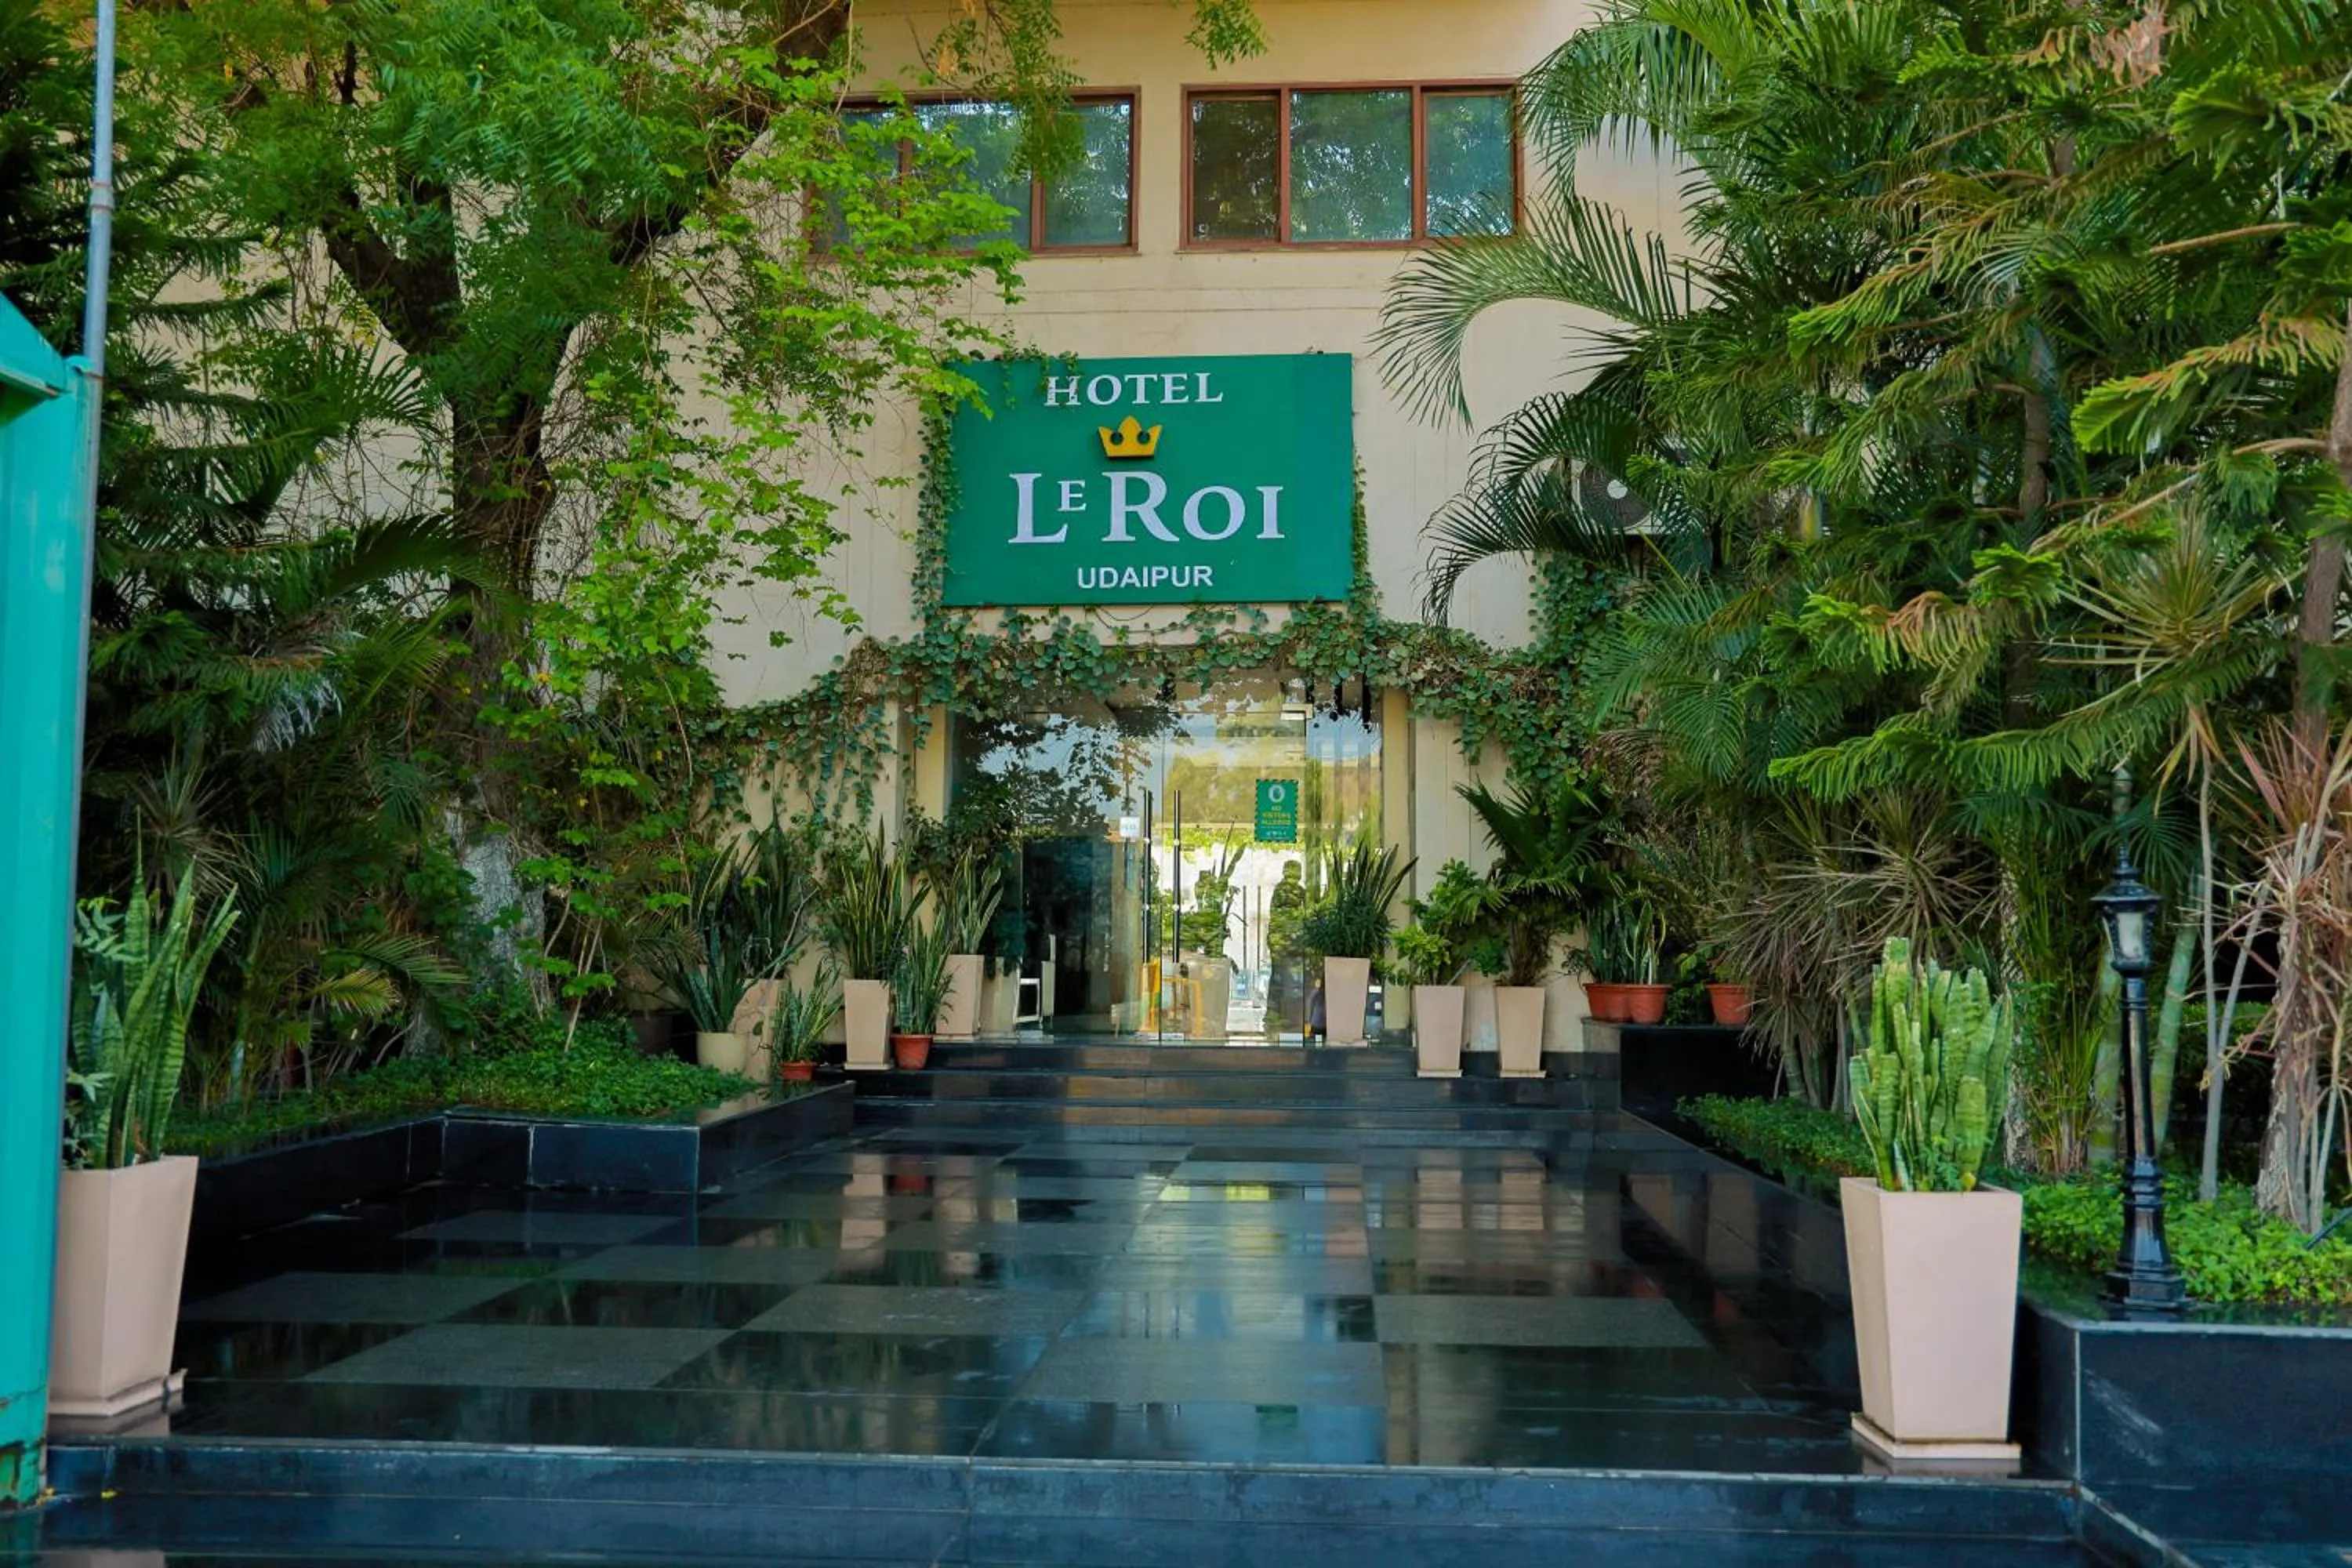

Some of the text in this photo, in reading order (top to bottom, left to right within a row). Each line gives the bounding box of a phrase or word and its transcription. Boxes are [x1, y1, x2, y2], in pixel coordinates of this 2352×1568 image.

[1044, 372, 1224, 406] HOTEL
[1101, 470, 1286, 543] ROI
[1077, 565, 1214, 590] UDAIPUR
